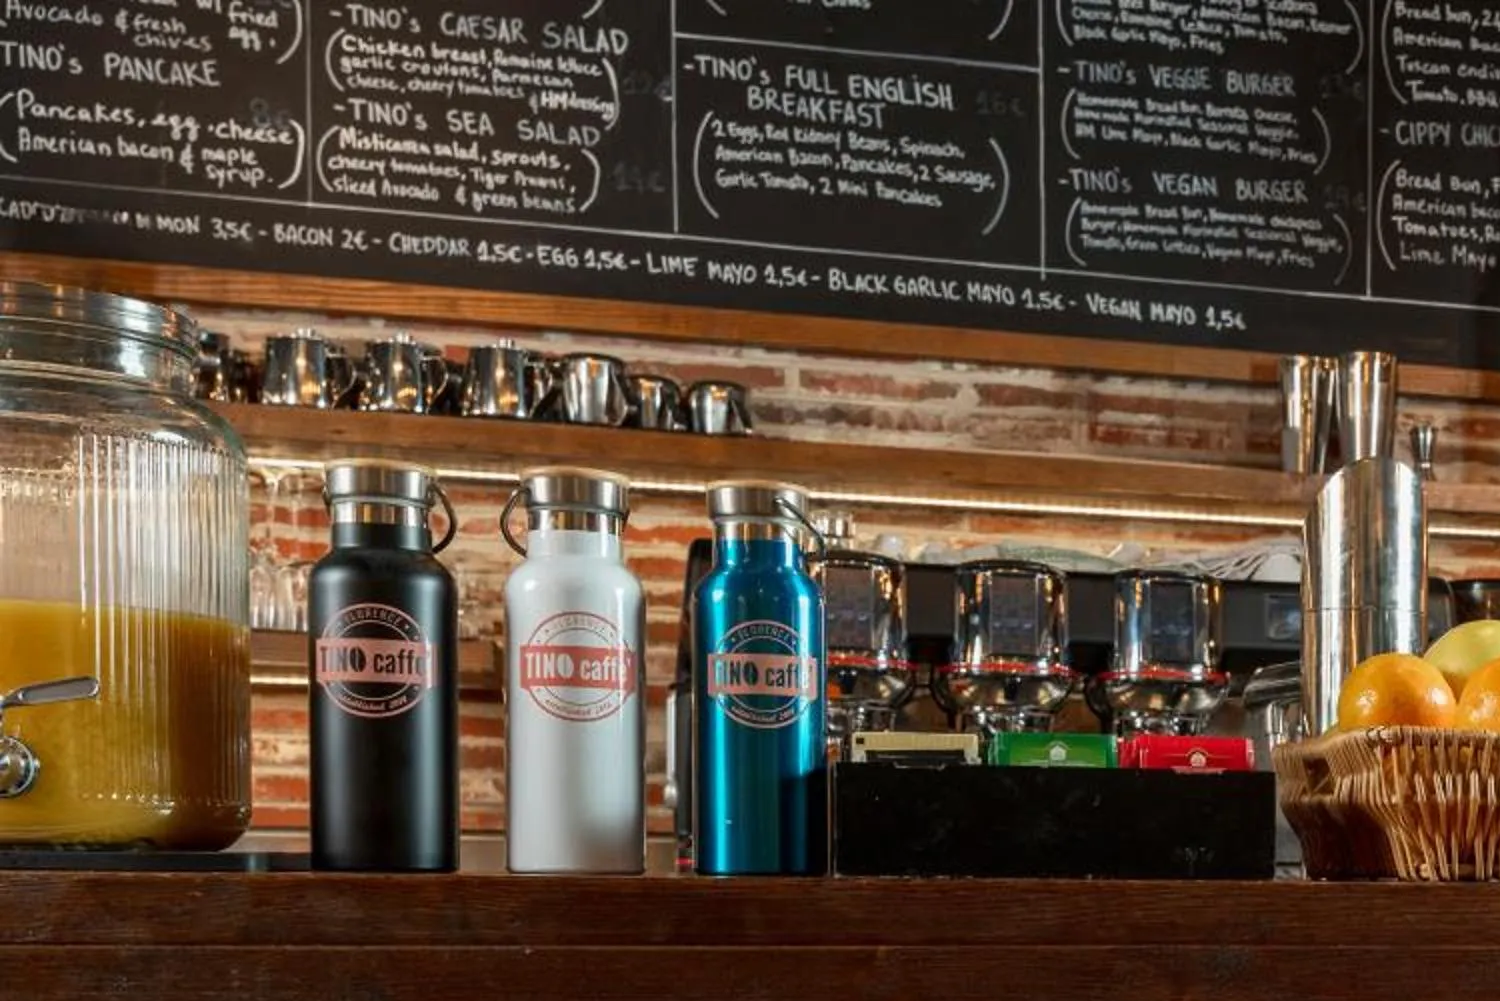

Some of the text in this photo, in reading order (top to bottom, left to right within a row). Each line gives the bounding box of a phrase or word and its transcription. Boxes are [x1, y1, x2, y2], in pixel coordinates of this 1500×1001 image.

[5, 0, 103, 26] Avocado
[133, 13, 186, 35] fresh
[228, 1, 278, 28] fried
[134, 33, 212, 51] chives
[346, 3, 629, 55] TINO's CAESAR SALAD
[1393, 26, 1463, 50] American
[340, 34, 425, 58] Chicken
[0, 41, 221, 87] TINO's PANCAKE
[339, 56, 396, 74] garlic
[694, 55, 771, 85] TINO's
[785, 65, 838, 95] FULL
[1073, 60, 1137, 85] TINO's
[1148, 63, 1212, 91] VEGGIE
[1226, 69, 1297, 97] BURGER
[747, 85, 885, 129] BREAKFAST
[347, 98, 601, 147] TINO's SEA SALAD
[711, 119, 726, 138] 2
[1395, 120, 1451, 146] CIPPY
[18, 127, 112, 156] American
[117, 136, 174, 162] bacon
[201, 146, 258, 167] maple
[714, 144, 783, 164] American
[918, 165, 931, 181] 2
[469, 167, 509, 190] Tiger
[715, 168, 758, 189] Garlic
[818, 176, 834, 195] 2
[1068, 166, 1133, 193] TINO's
[1152, 170, 1218, 196] VEGAN
[1235, 177, 1309, 204] BURGER
[1395, 168, 1442, 191] Bread
[472, 191, 518, 212] green
[522, 190, 576, 213] beans
[1392, 193, 1467, 219] American
[1400, 240, 1446, 264] Lime
[1451, 244, 1497, 273] Mayo
[273, 222, 334, 246] BACON
[341, 229, 369, 250] 2€
[388, 231, 472, 257] CHEDDAR
[536, 245, 578, 268] EGG
[646, 251, 698, 276] LIME
[707, 260, 757, 285] MAYO
[828, 267, 890, 294] BLACK
[893, 275, 962, 300] GARLIC
[966, 280, 1016, 306] MAYO
[1085, 292, 1143, 322] VEGAN
[1150, 302, 1198, 327] MAYO
[319, 645, 367, 673] TINO
[524, 651, 575, 679] TINO
